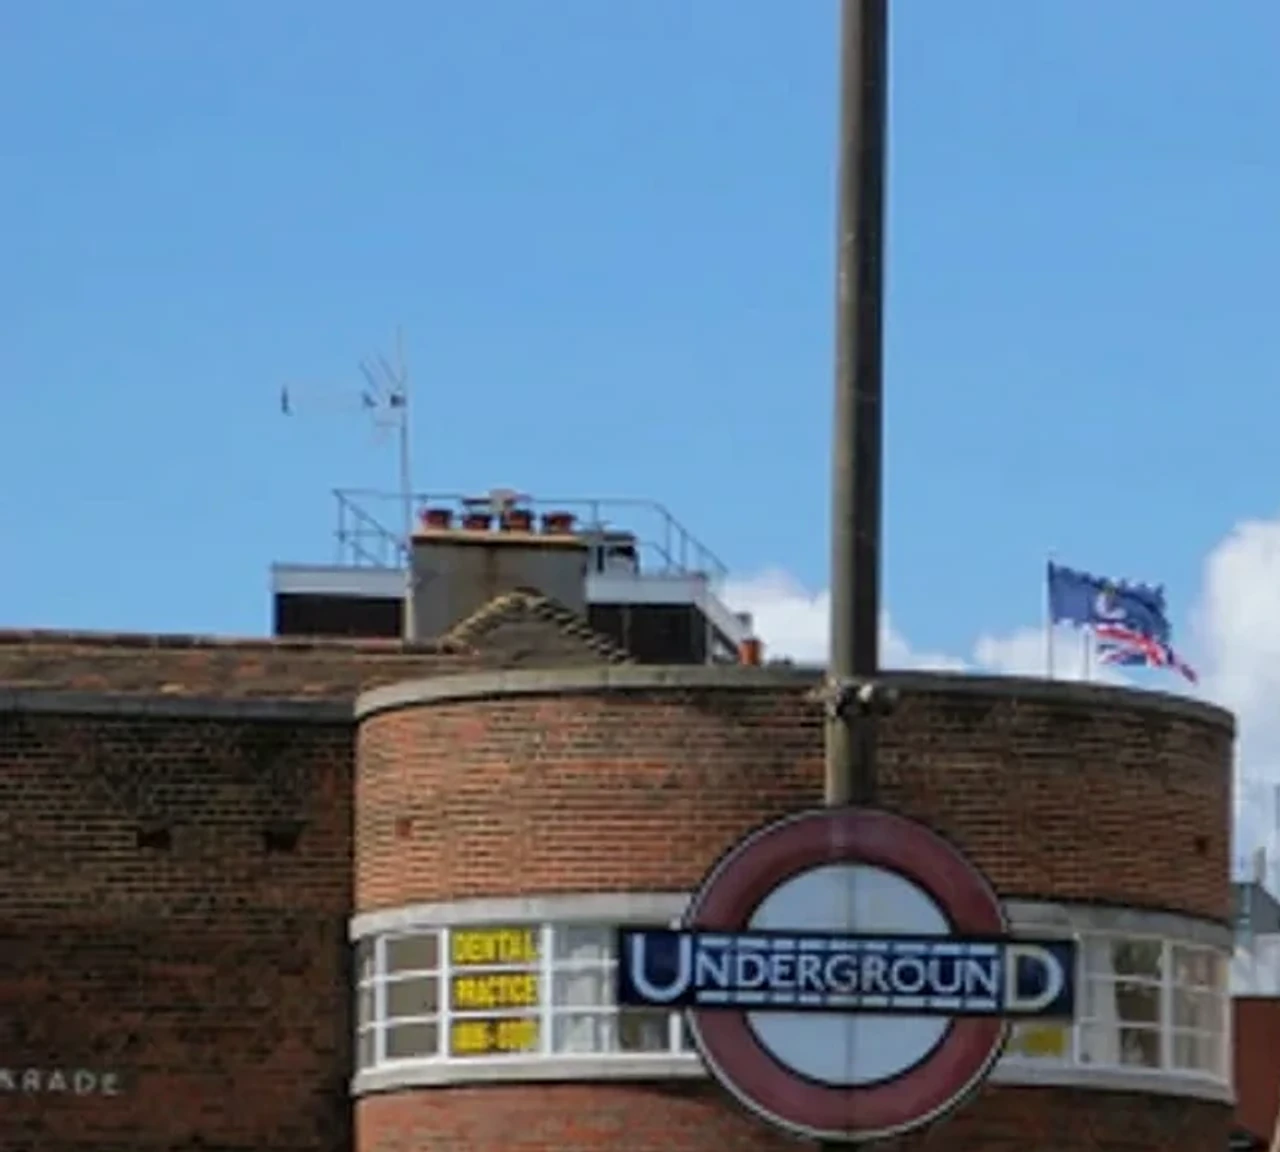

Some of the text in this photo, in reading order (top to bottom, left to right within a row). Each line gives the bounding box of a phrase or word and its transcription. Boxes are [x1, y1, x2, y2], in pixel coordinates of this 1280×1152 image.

[453, 930, 538, 962] DENTAL
[631, 932, 1066, 1013] UNDERGROUND
[455, 974, 537, 1008] PRACTICE
